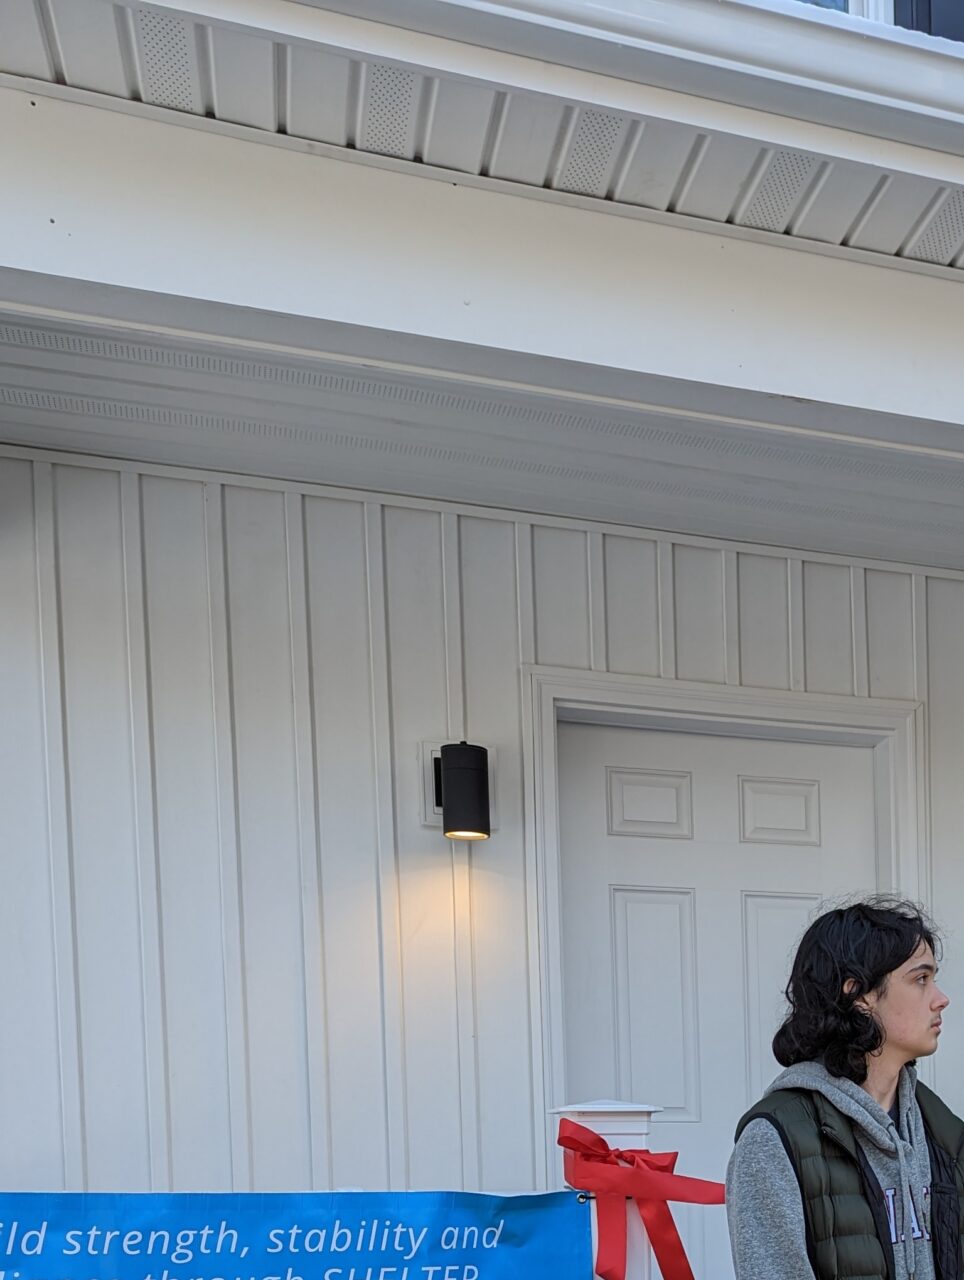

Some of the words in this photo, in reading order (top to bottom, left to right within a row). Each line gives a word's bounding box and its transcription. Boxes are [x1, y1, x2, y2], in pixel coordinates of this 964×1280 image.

[0, 1221, 47, 1255] ld
[62, 1221, 250, 1264] strength,
[266, 1219, 428, 1260] stability
[441, 1219, 504, 1250] and
